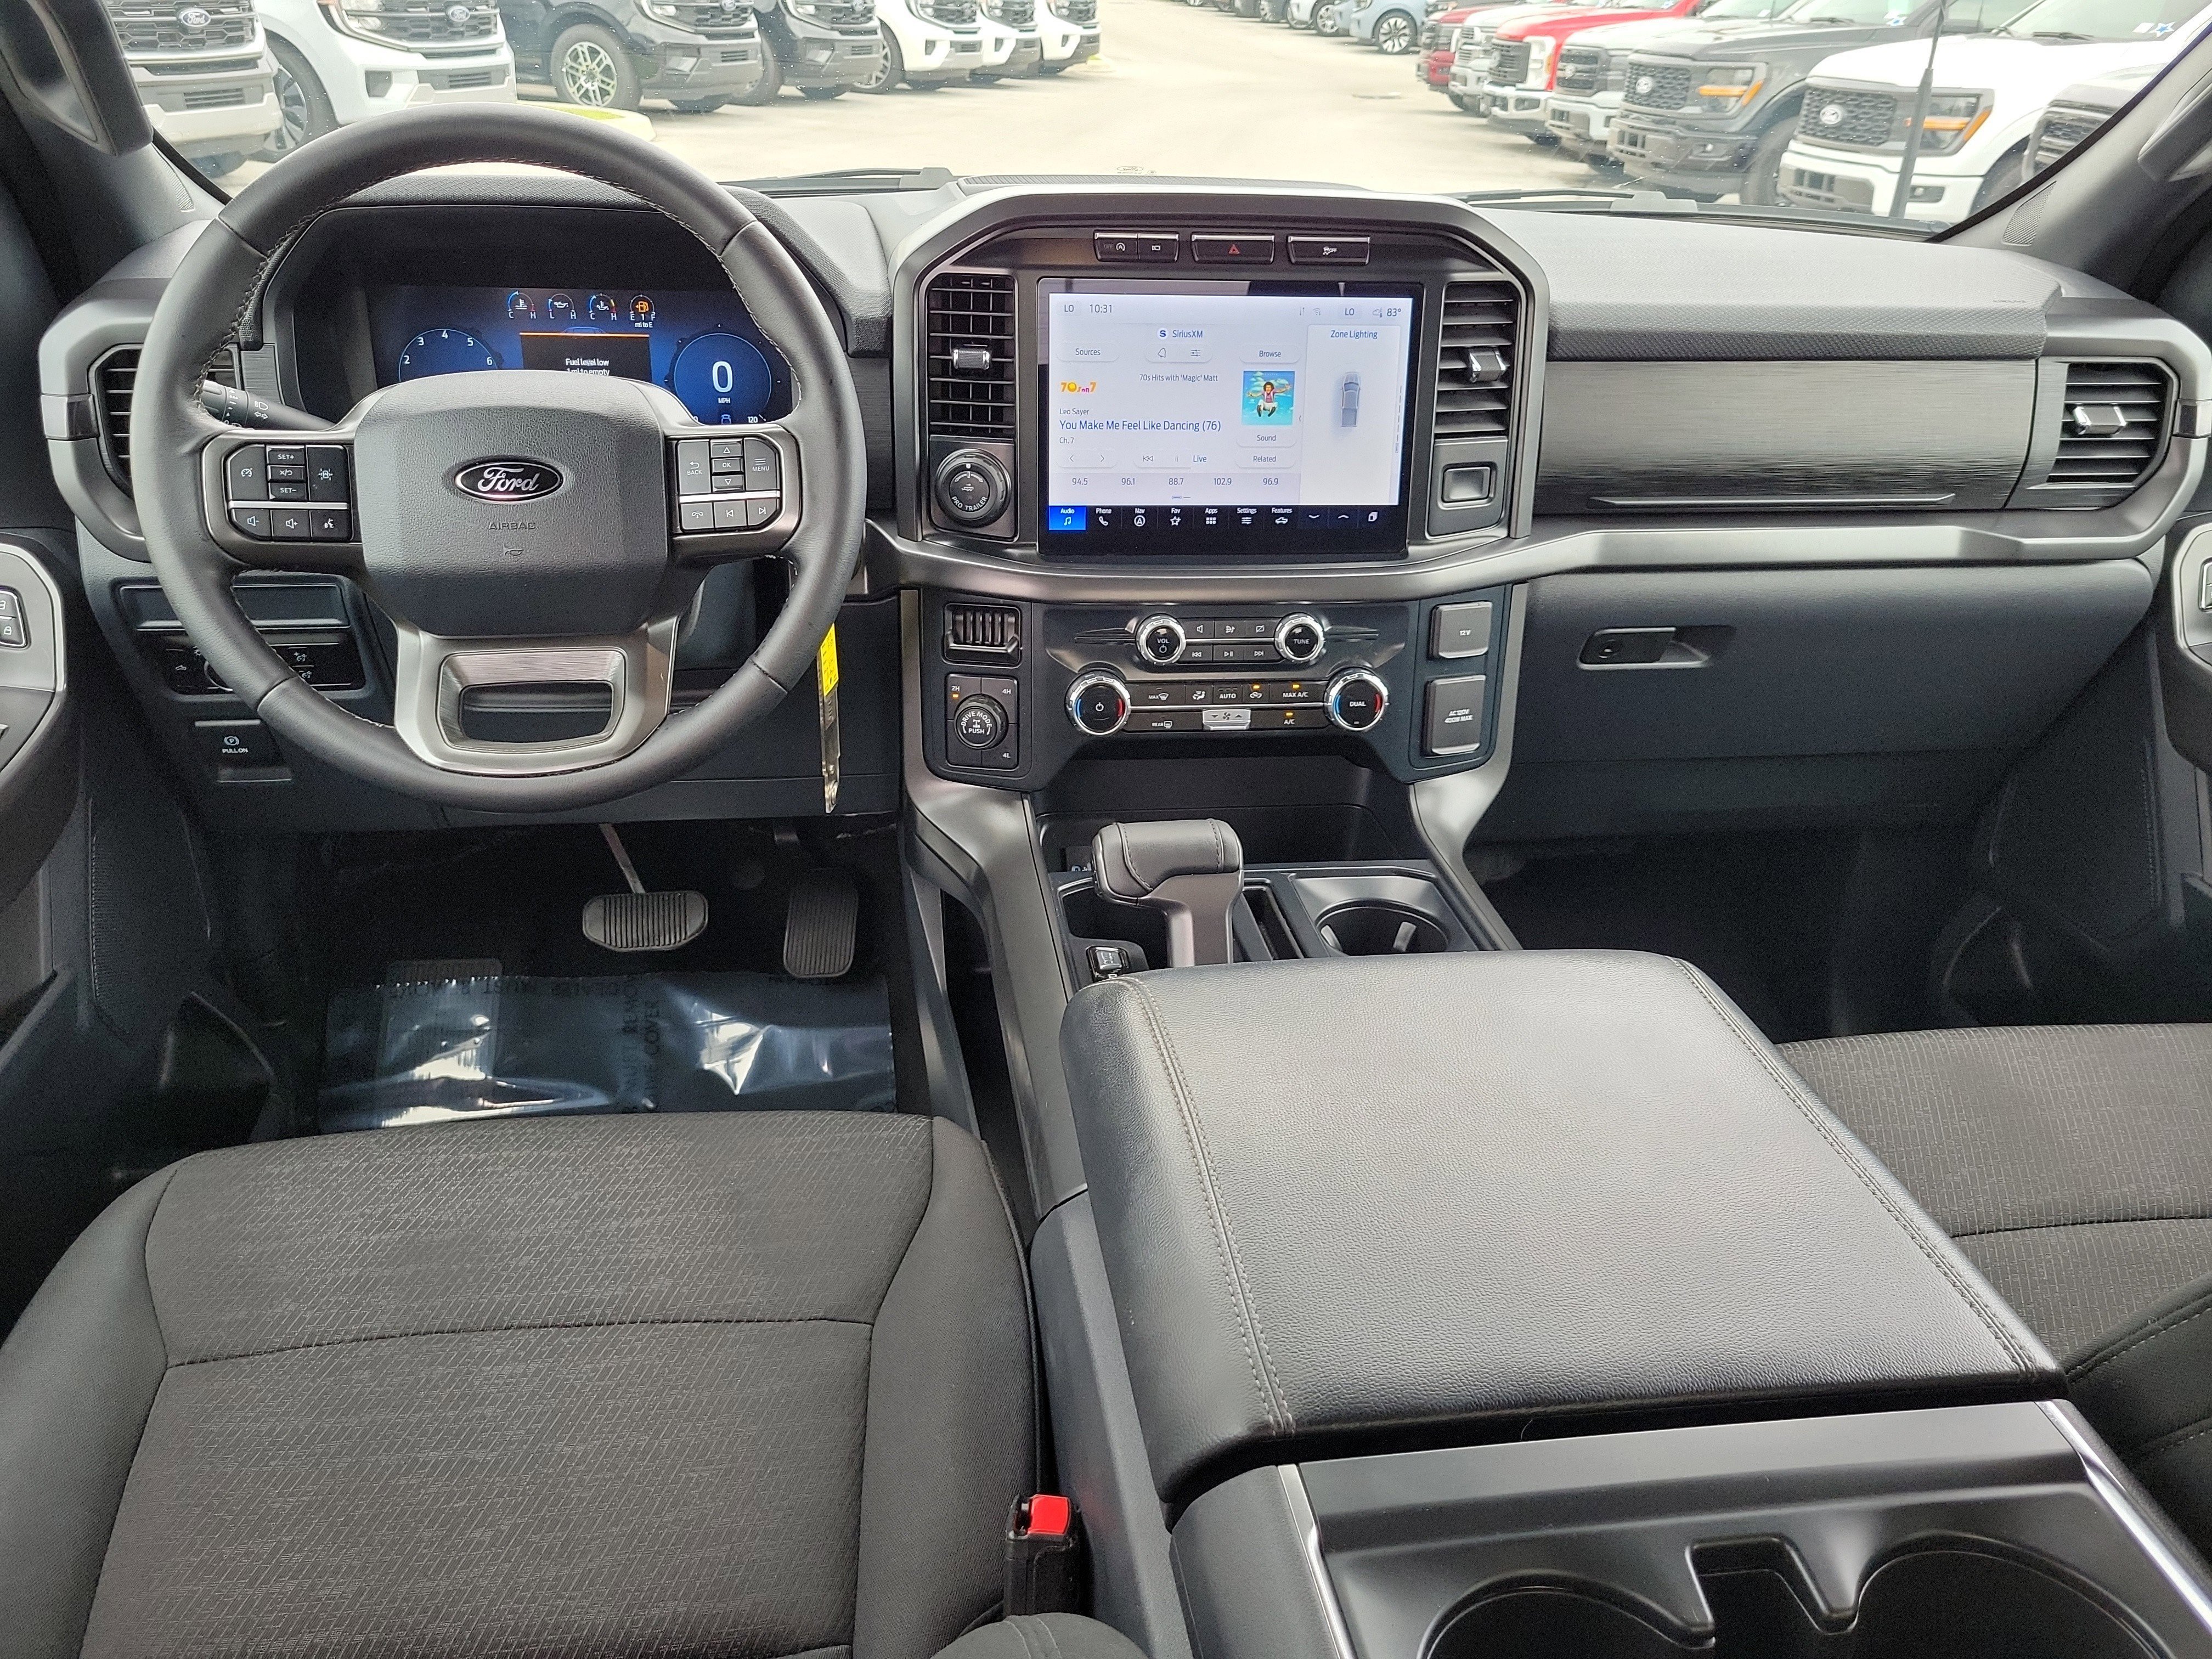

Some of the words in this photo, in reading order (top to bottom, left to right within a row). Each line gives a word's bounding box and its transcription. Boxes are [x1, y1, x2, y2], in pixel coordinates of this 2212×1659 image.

[1090, 304, 1113, 313] 10:31
[442, 330, 448, 338] 4
[1172, 330, 1203, 338] SiriusXM
[1350, 330, 1378, 339] Lighting
[417, 337, 424, 346] 3
[467, 337, 473, 346] 5
[404, 356, 410, 364] 2
[487, 357, 493, 365] 6
[713, 361, 733, 392] 0
[1060, 420, 1077, 430] You
[1080, 420, 1104, 430] Make
[1107, 421, 1120, 430] Me
[1122, 420, 1141, 430] Feel
[1143, 420, 1161, 430] Like
[1164, 421, 1199, 432] Dancing
[1202, 420, 1221, 432] (76)
[478, 467, 540, 492] Ford
[952, 496, 963, 508] PRO
[965, 496, 988, 511] TRAILER
[961, 711, 975, 726] DRIVE
[977, 711, 992, 727] MODE
[644, 1000, 659, 1056] COVER
